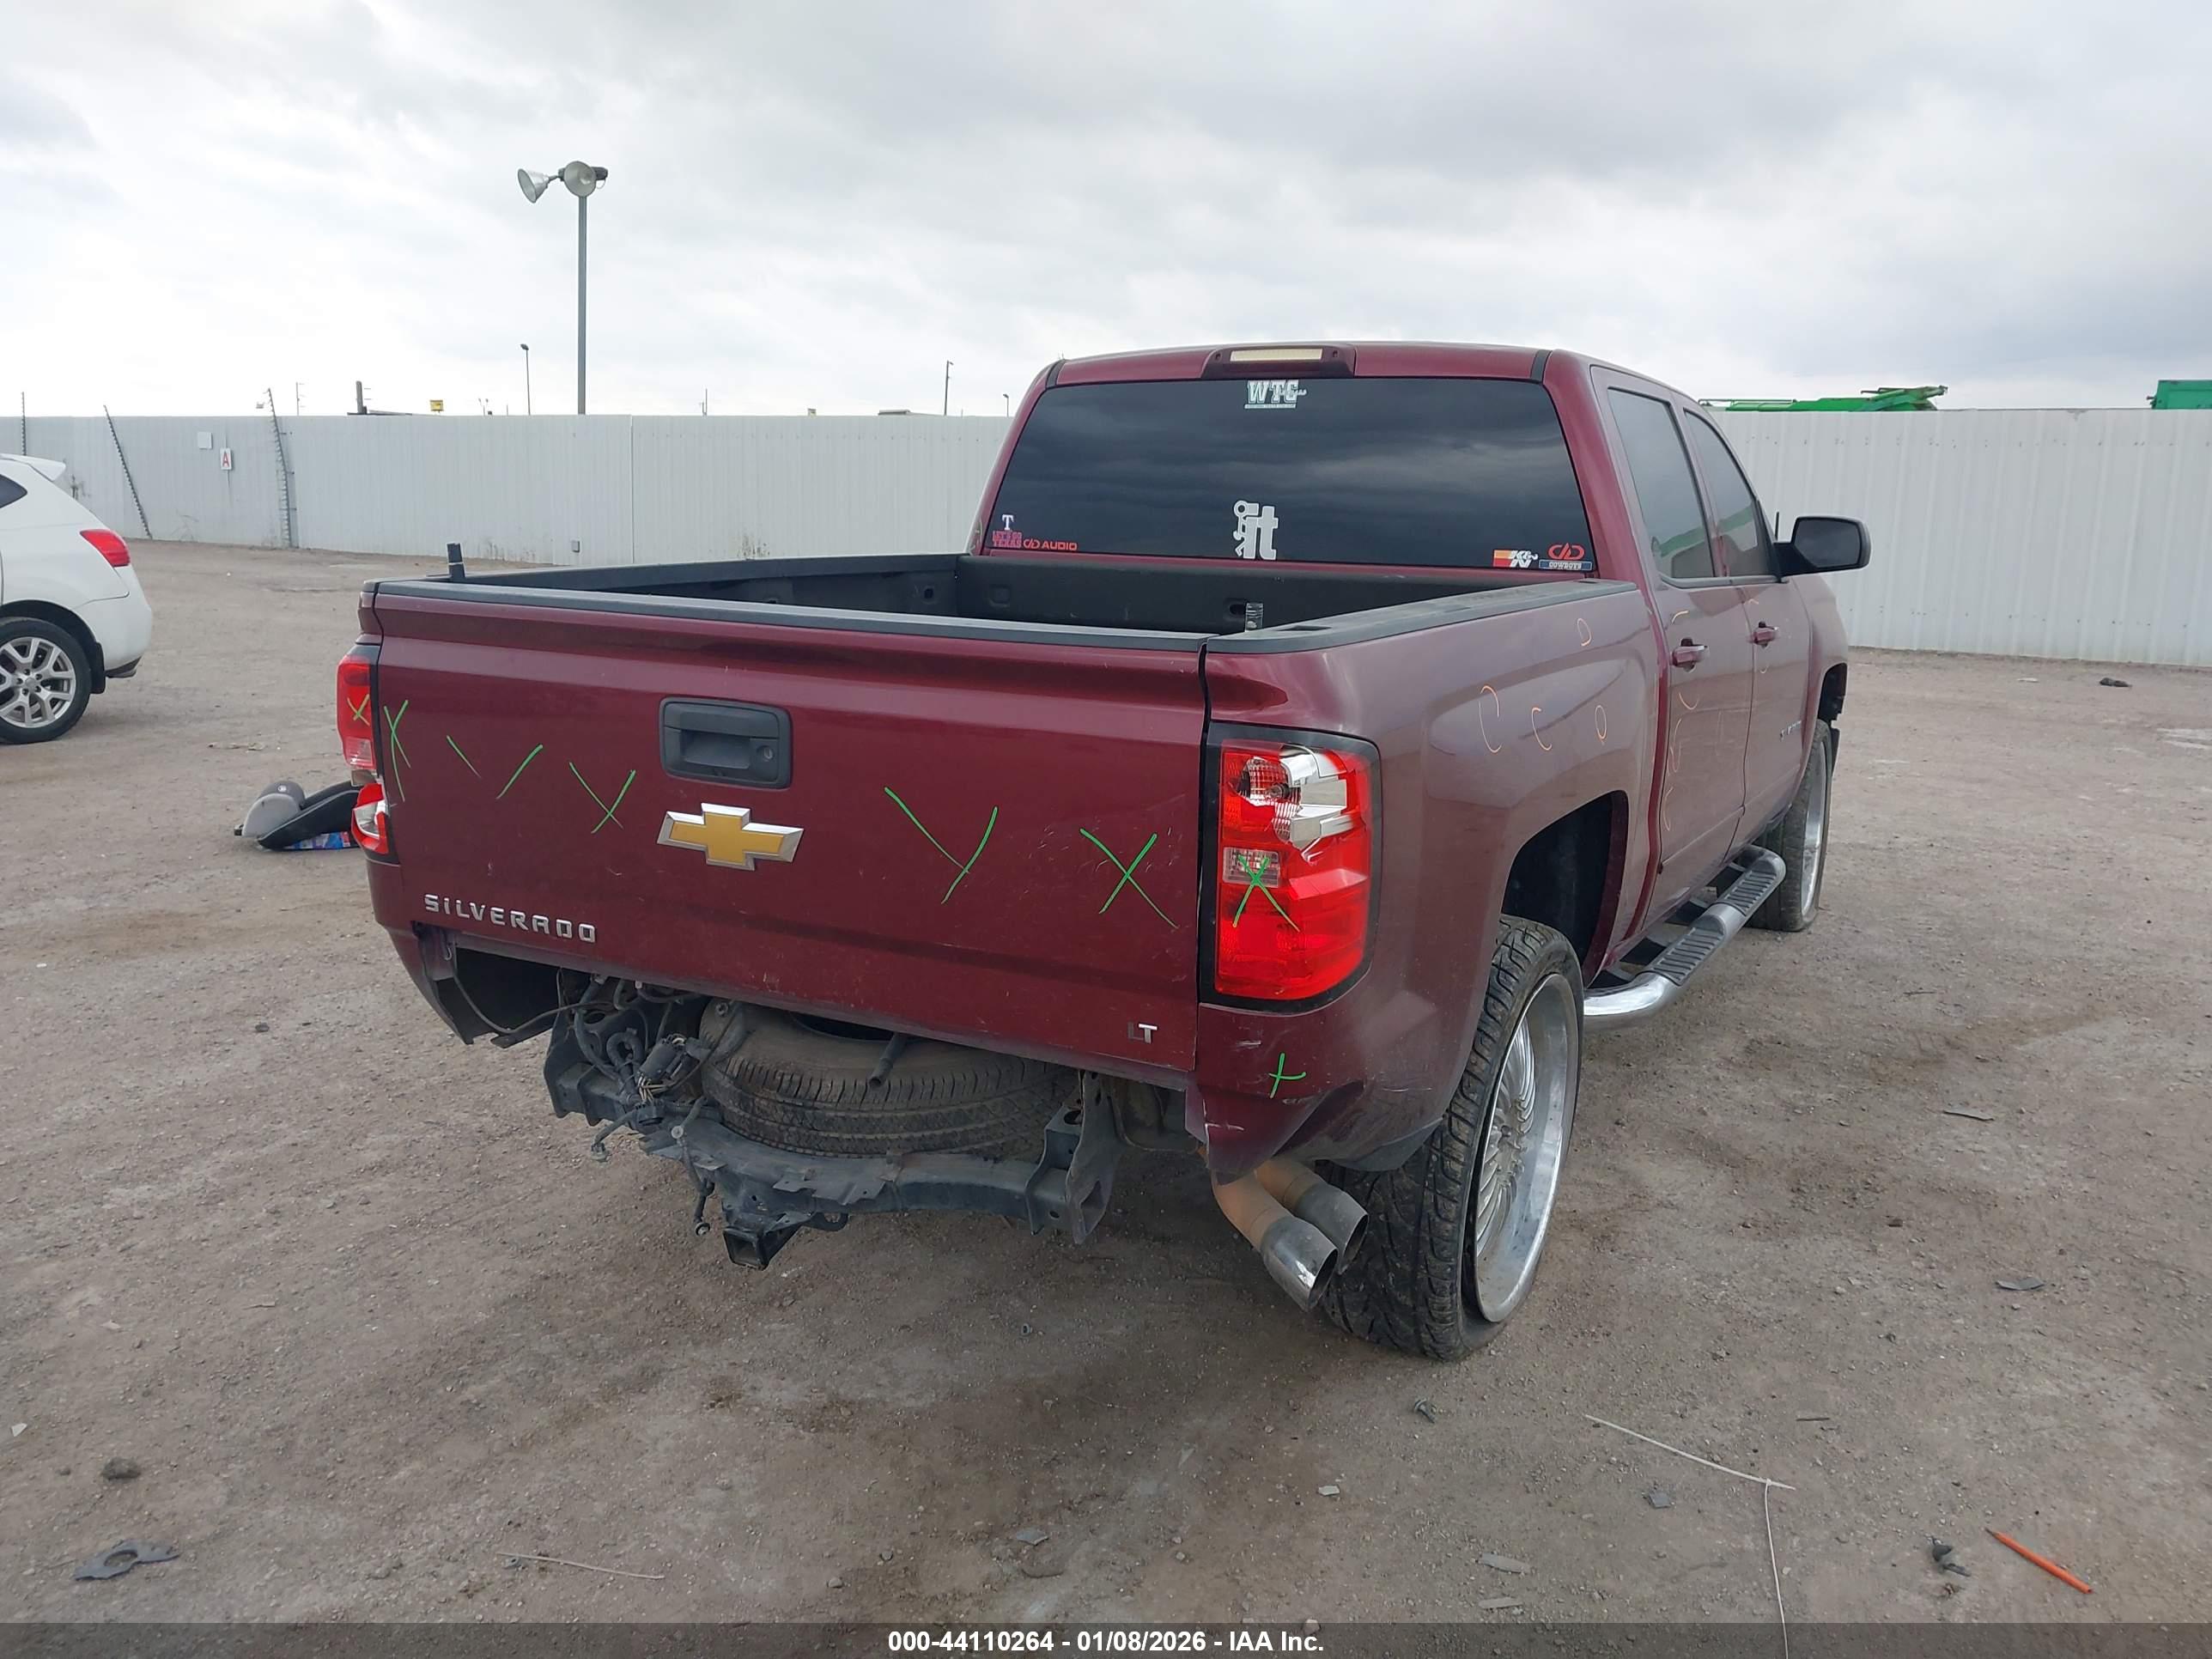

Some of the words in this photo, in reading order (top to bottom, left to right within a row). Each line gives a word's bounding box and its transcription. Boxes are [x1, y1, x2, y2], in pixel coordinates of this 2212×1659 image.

[222, 451, 230, 468] A
[1002, 514, 1014, 531] T
[1243, 502, 1279, 561] it
[1042, 540, 1078, 550] AUDIO
[424, 894, 596, 943] SILVERADO
[1127, 1022, 1158, 1044] LT
